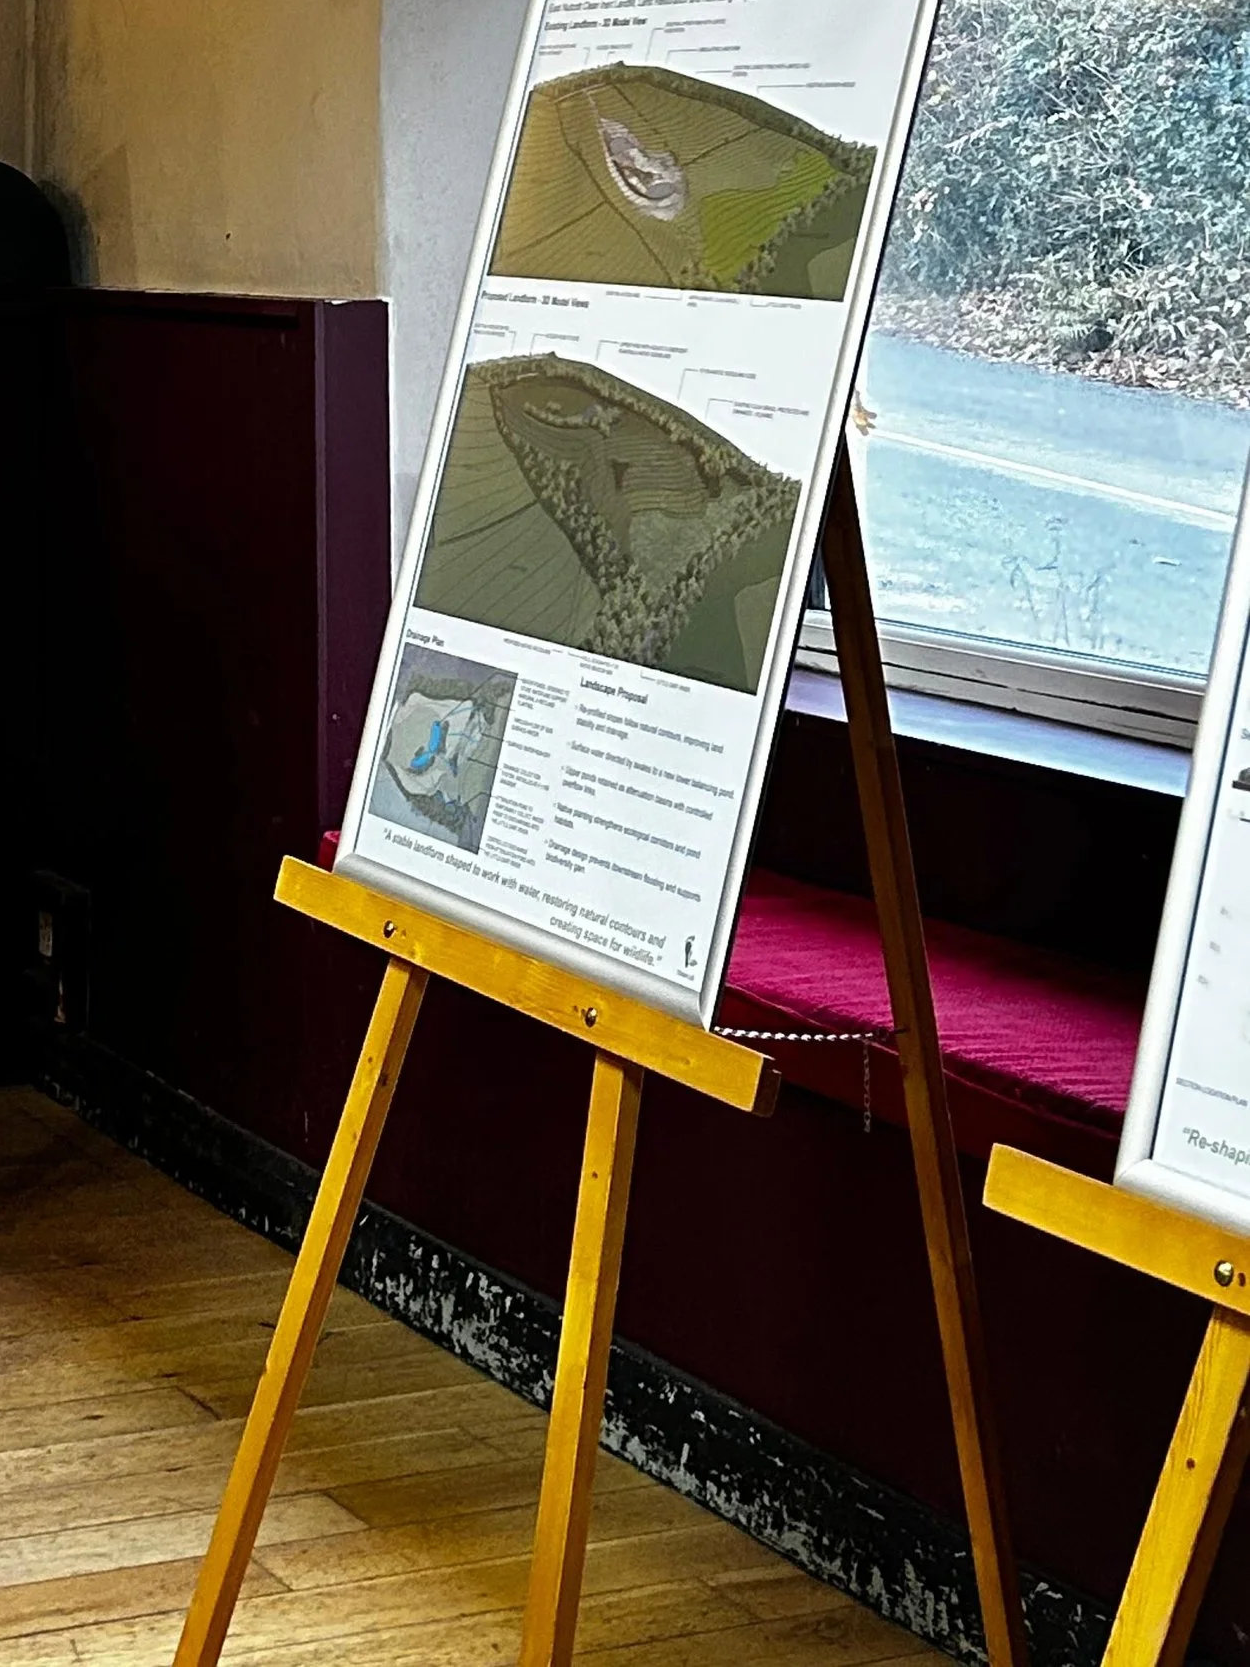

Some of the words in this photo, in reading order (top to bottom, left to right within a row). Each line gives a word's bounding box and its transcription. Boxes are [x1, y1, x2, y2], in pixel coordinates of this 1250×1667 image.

[612, 16, 632, 27] Model
[580, 676, 616, 697] Landscape
[617, 686, 649, 704] Proposal
[392, 832, 413, 849] stable
[413, 839, 444, 860] landform
[444, 853, 473, 871] shaped
[472, 864, 482, 875] to
[482, 868, 500, 883] work
[501, 875, 518, 889] with
[518, 884, 540, 901] water,
[542, 892, 578, 916] restoring
[579, 907, 609, 925] natural
[609, 918, 646, 941] contours
[647, 933, 666, 948] and
[550, 915, 582, 939] creating
[583, 928, 608, 946] space
[608, 936, 623, 951] for
[1182, 1126, 1250, 1165] "Re-shapi
